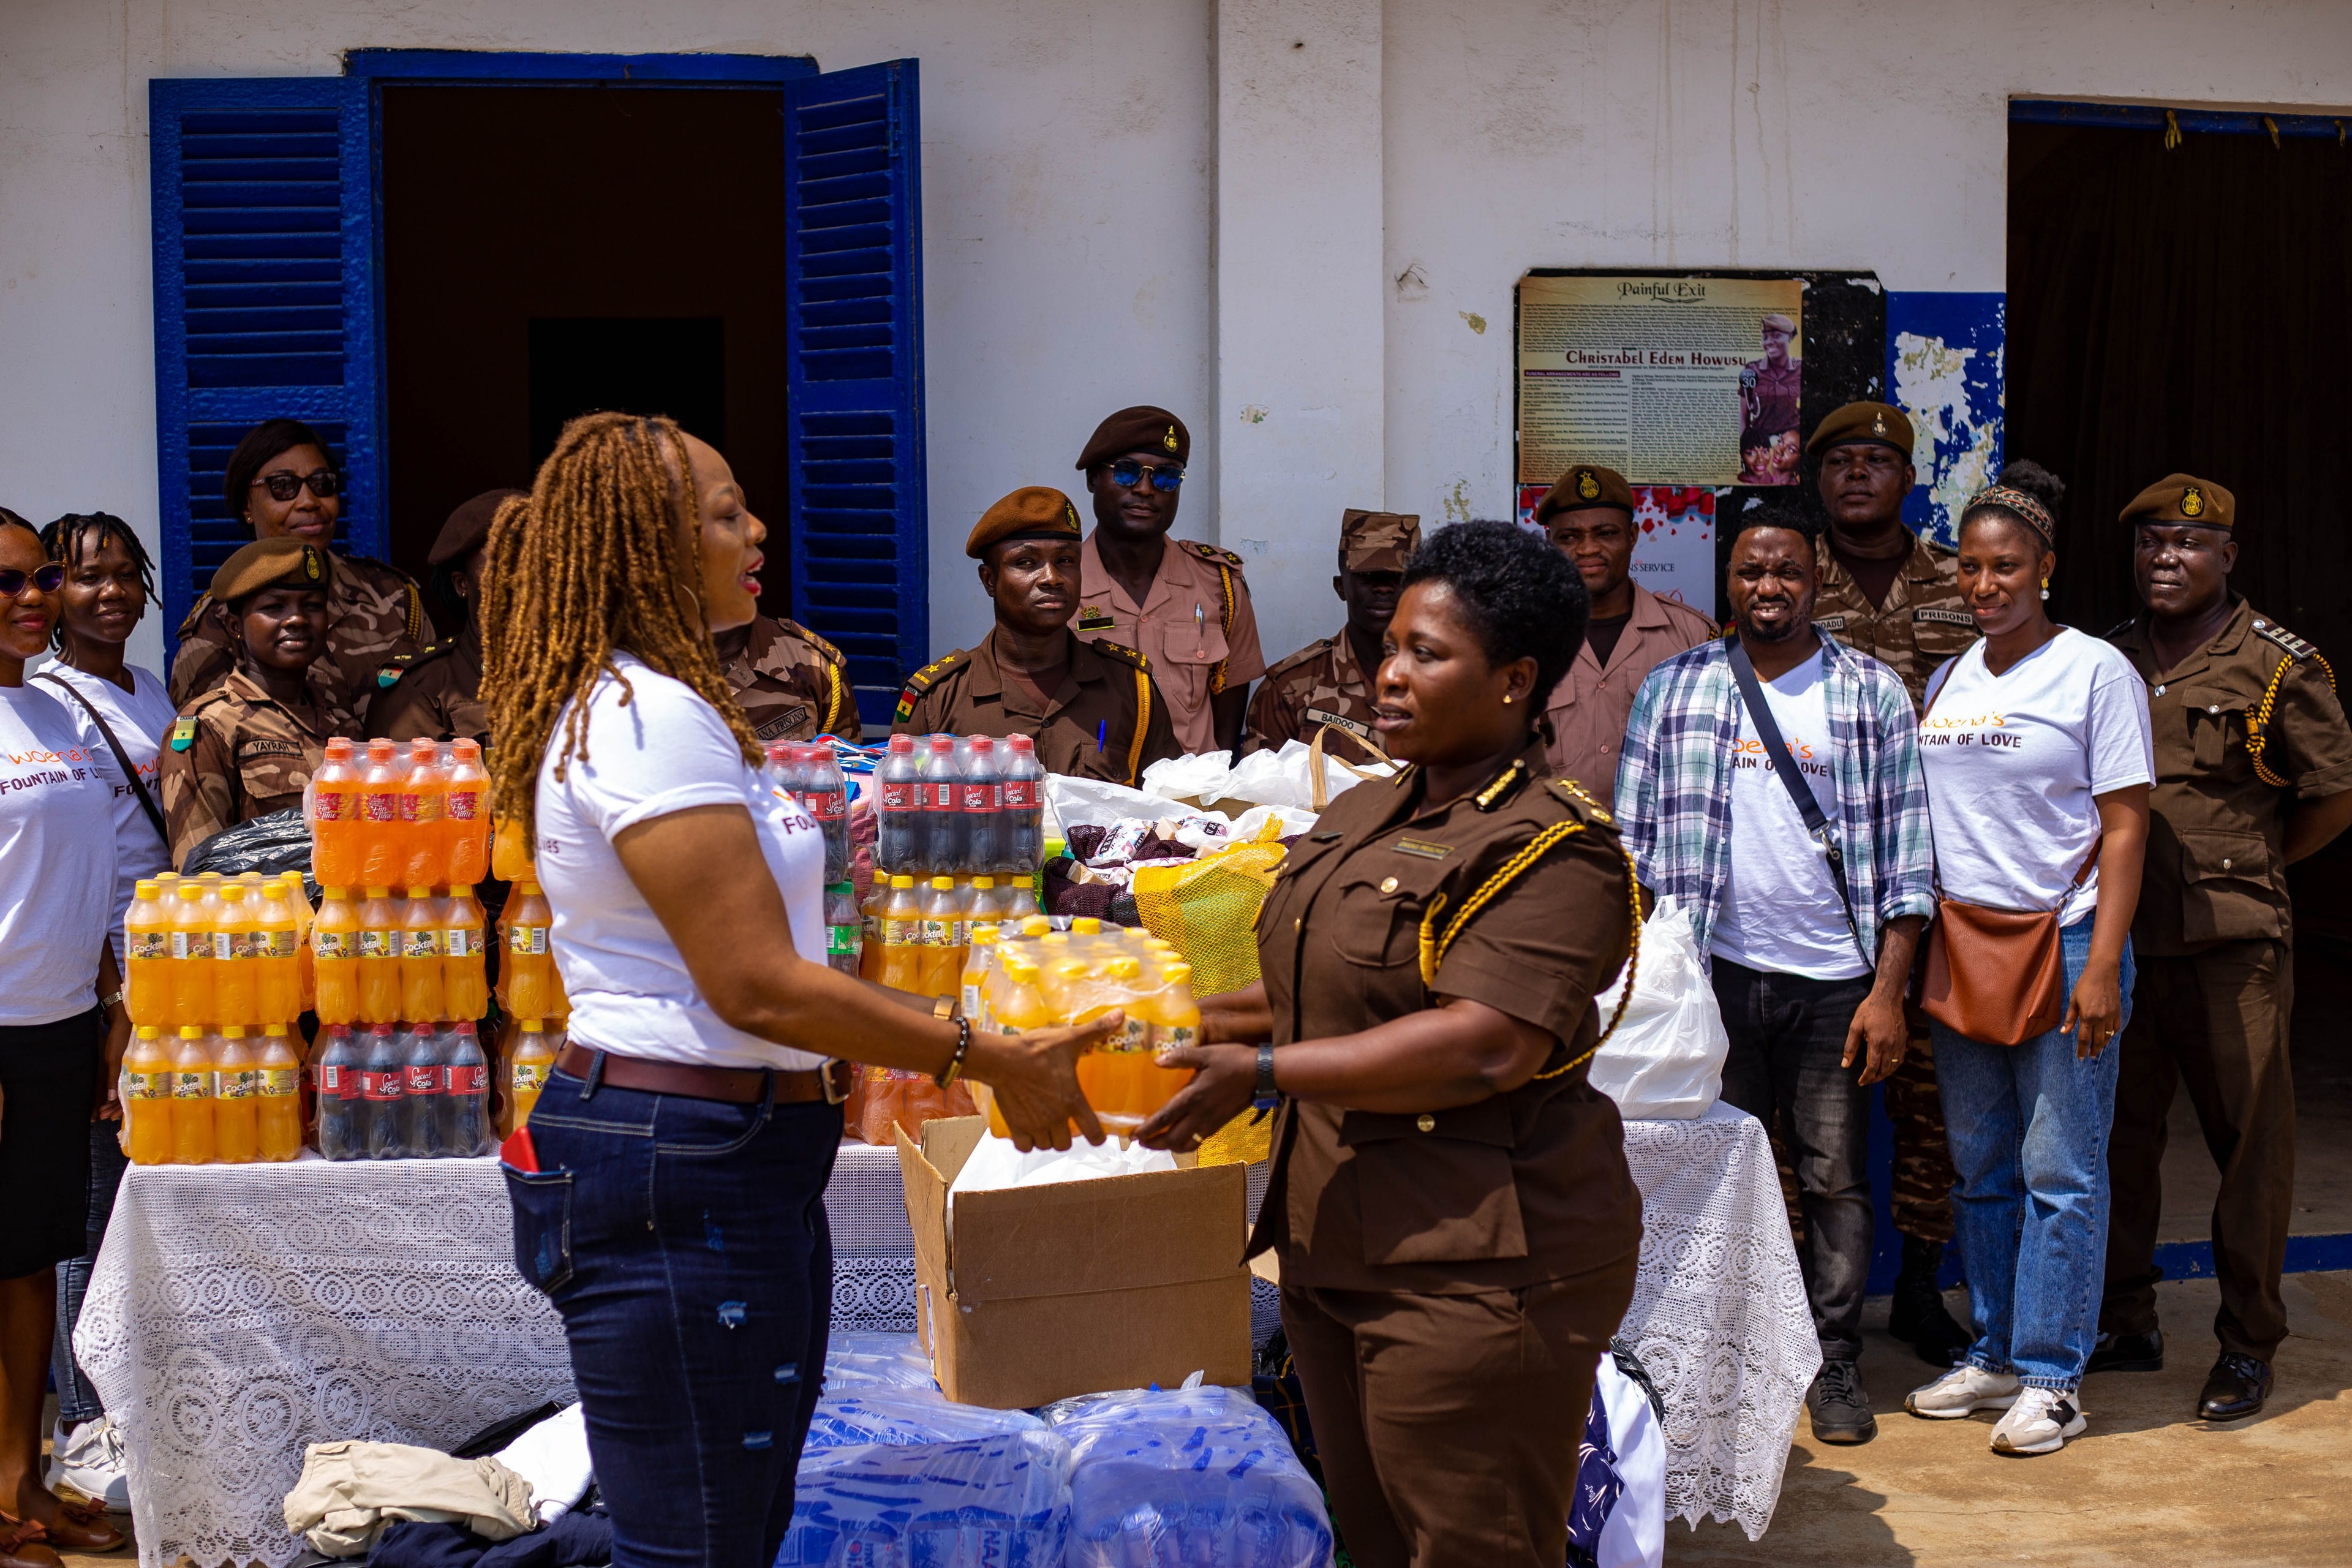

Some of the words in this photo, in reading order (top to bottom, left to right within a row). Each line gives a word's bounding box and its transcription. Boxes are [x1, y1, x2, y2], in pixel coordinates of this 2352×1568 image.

[1618, 282, 1669, 301] Painful
[1674, 282, 1706, 296] Exit
[1742, 377, 1756, 388] 30
[1640, 563, 1675, 572] SERVICE
[1921, 611, 1971, 623] PRISONS
[757, 728, 772, 741] ANA
[774, 709, 805, 732] PRISONS
[1321, 713, 1354, 730] BAIDOO
[253, 742, 290, 752] YAYRAH
[1918, 734, 1950, 745] NTAIN
[1957, 733, 1975, 745] OF
[1981, 733, 2022, 748] LOVE
[8, 745, 94, 764] woena's
[1732, 757, 1757, 769] AIN
[1765, 760, 1777, 771] O
[1801, 762, 1828, 777] OVE
[0, 771, 69, 795] FOUNTAIN
[72, 767, 87, 781] OF
[883, 784, 902, 804] Special
[963, 785, 982, 806] Special
[1005, 782, 1023, 802] Special
[451, 804, 466, 813] Fun
[454, 811, 473, 820] Time
[133, 941, 163, 953] Cockta
[403, 937, 436, 951] Cocktail
[410, 1067, 432, 1088] Special
[224, 1080, 255, 1093] Cockta
